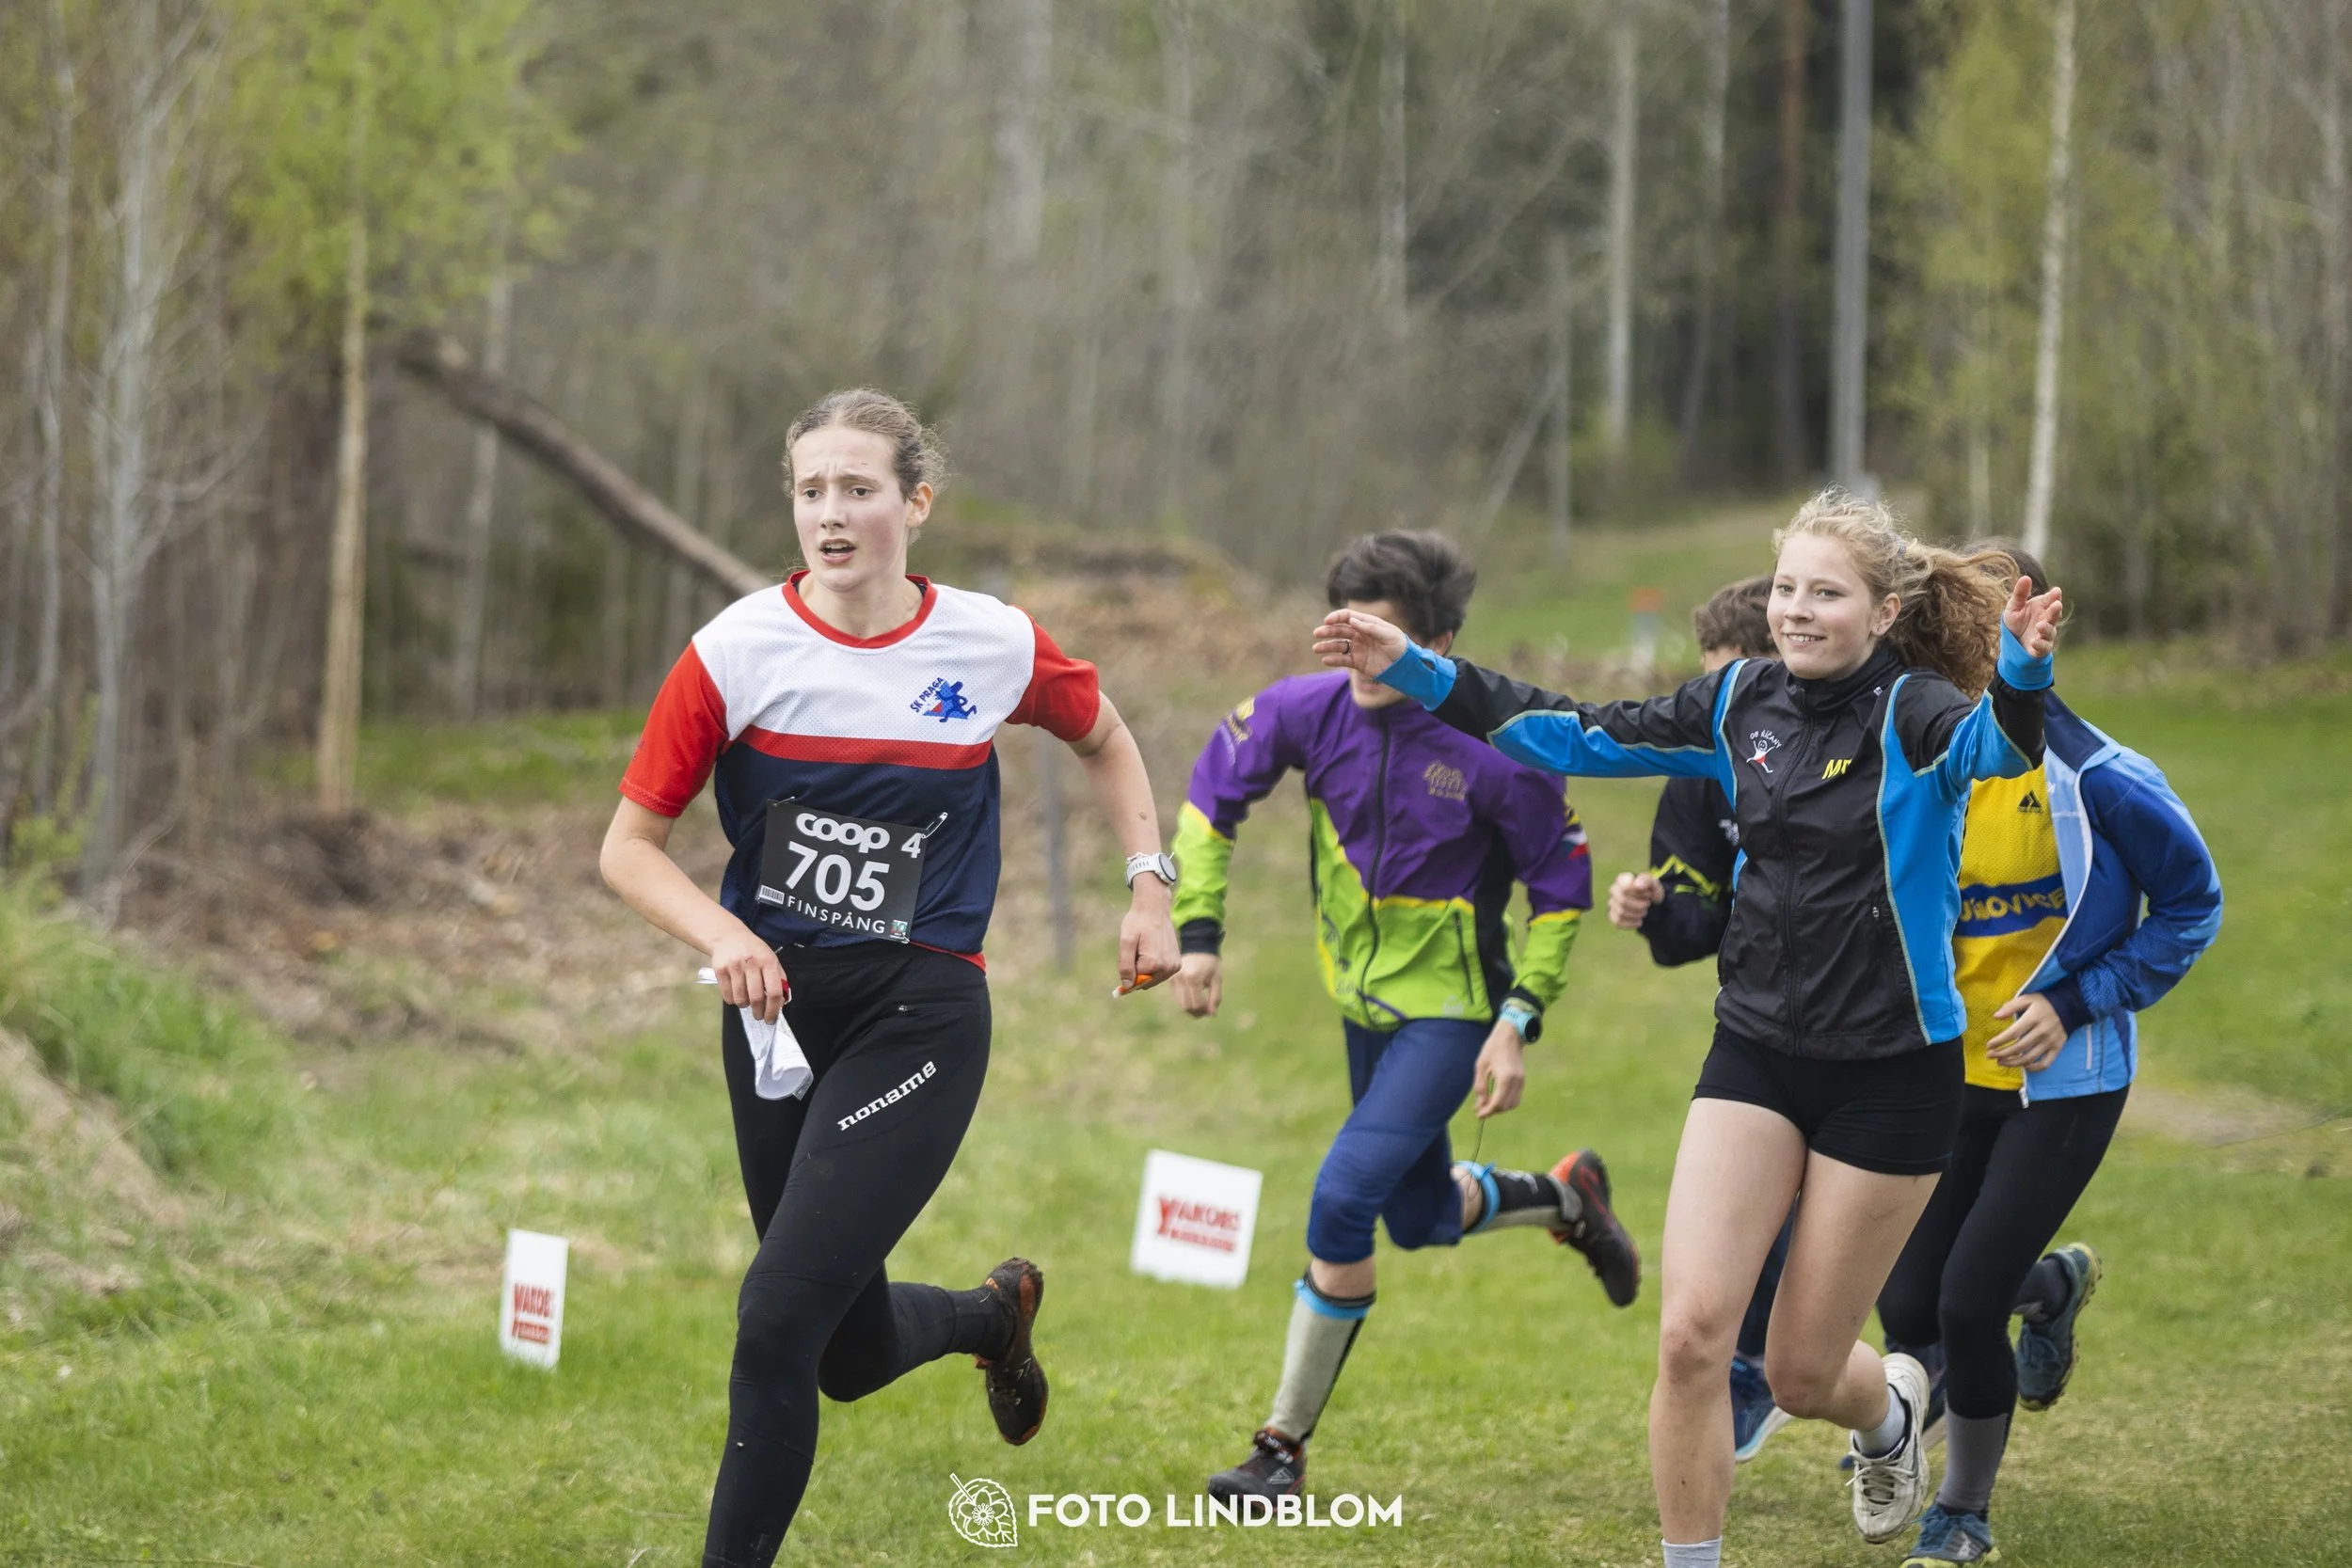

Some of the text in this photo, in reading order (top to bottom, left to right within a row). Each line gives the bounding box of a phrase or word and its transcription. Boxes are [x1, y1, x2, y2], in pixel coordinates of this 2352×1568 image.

[910, 676, 945, 713] SK PRAGA
[795, 812, 891, 854] coop
[900, 832, 923, 859] 4
[785, 840, 891, 911] 705
[787, 895, 886, 934] FINSPÅNG
[836, 1060, 937, 1132] noname
